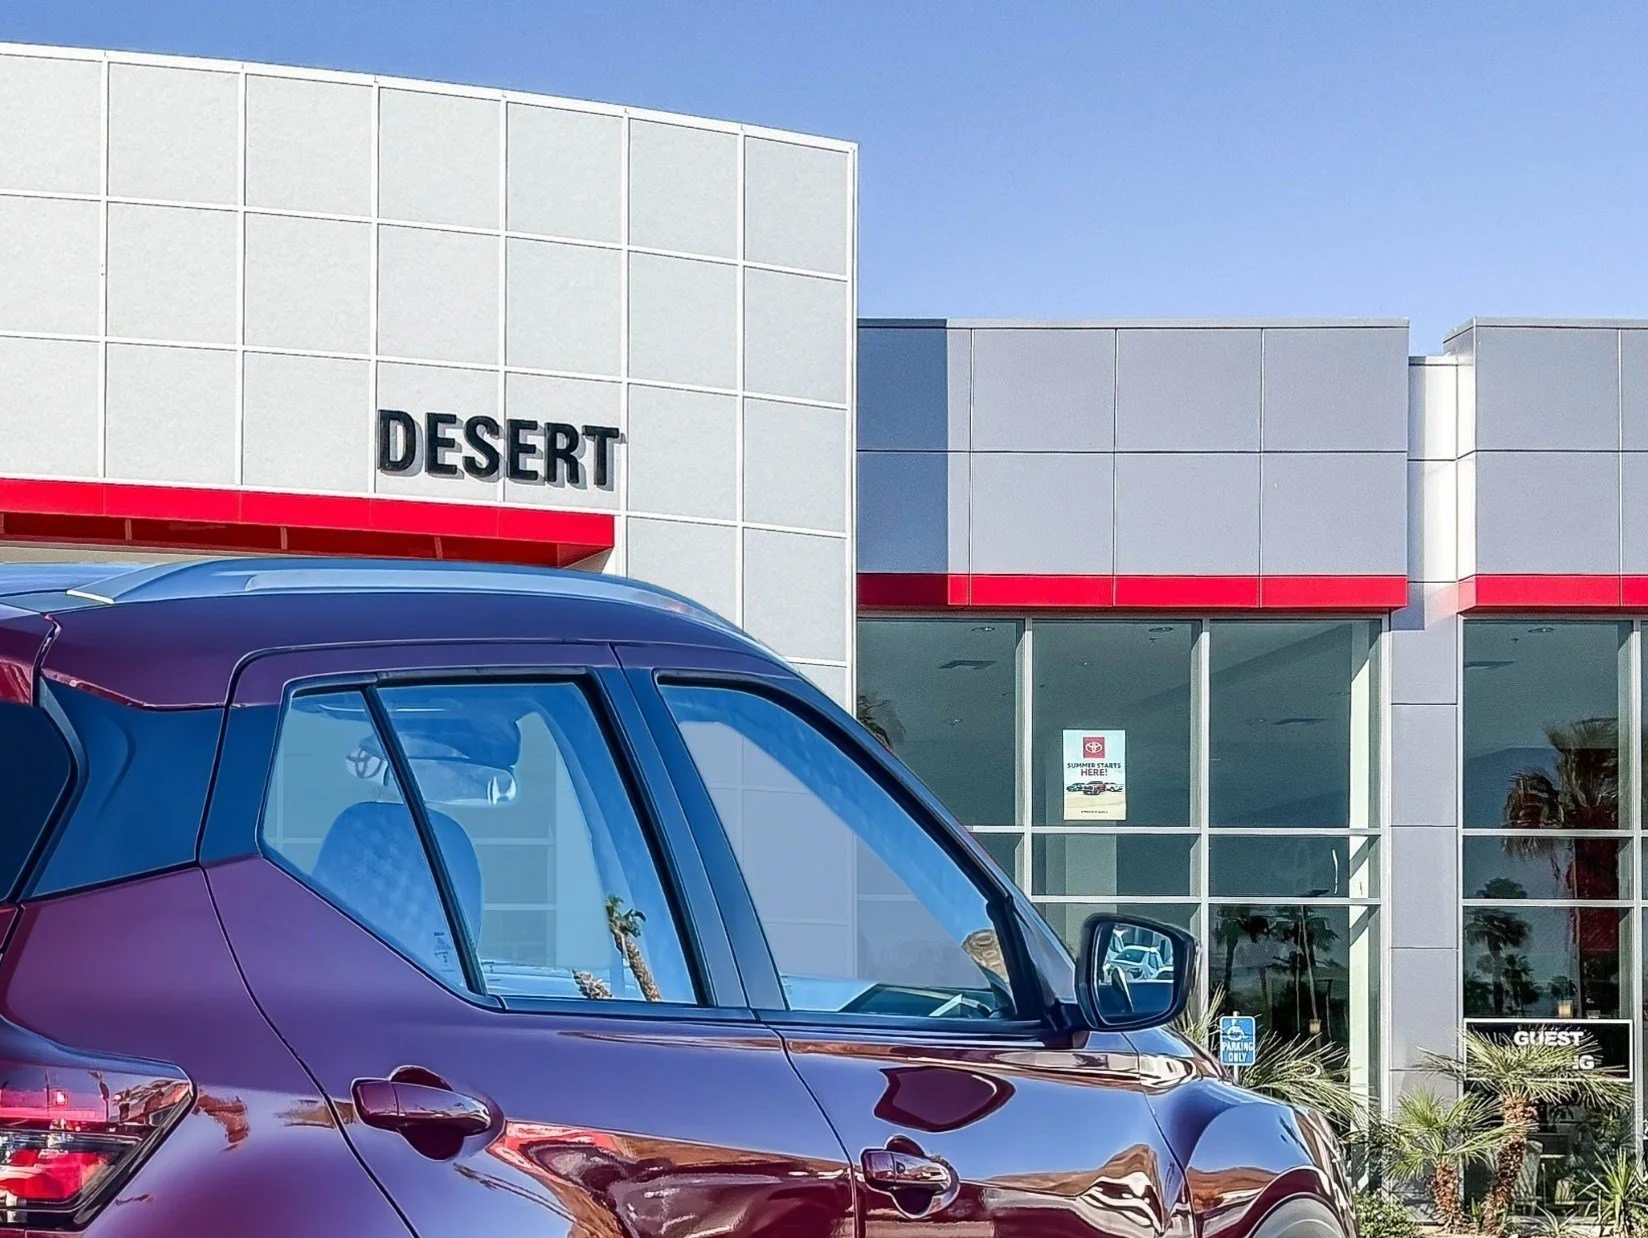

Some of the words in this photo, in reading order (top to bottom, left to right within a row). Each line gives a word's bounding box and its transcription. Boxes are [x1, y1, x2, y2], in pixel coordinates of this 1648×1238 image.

[377, 409, 620, 486] DESERT
[1513, 1030, 1584, 1046] GUEST
[1222, 1041, 1254, 1052] PARKING
[1228, 1052, 1248, 1062] ONLY
